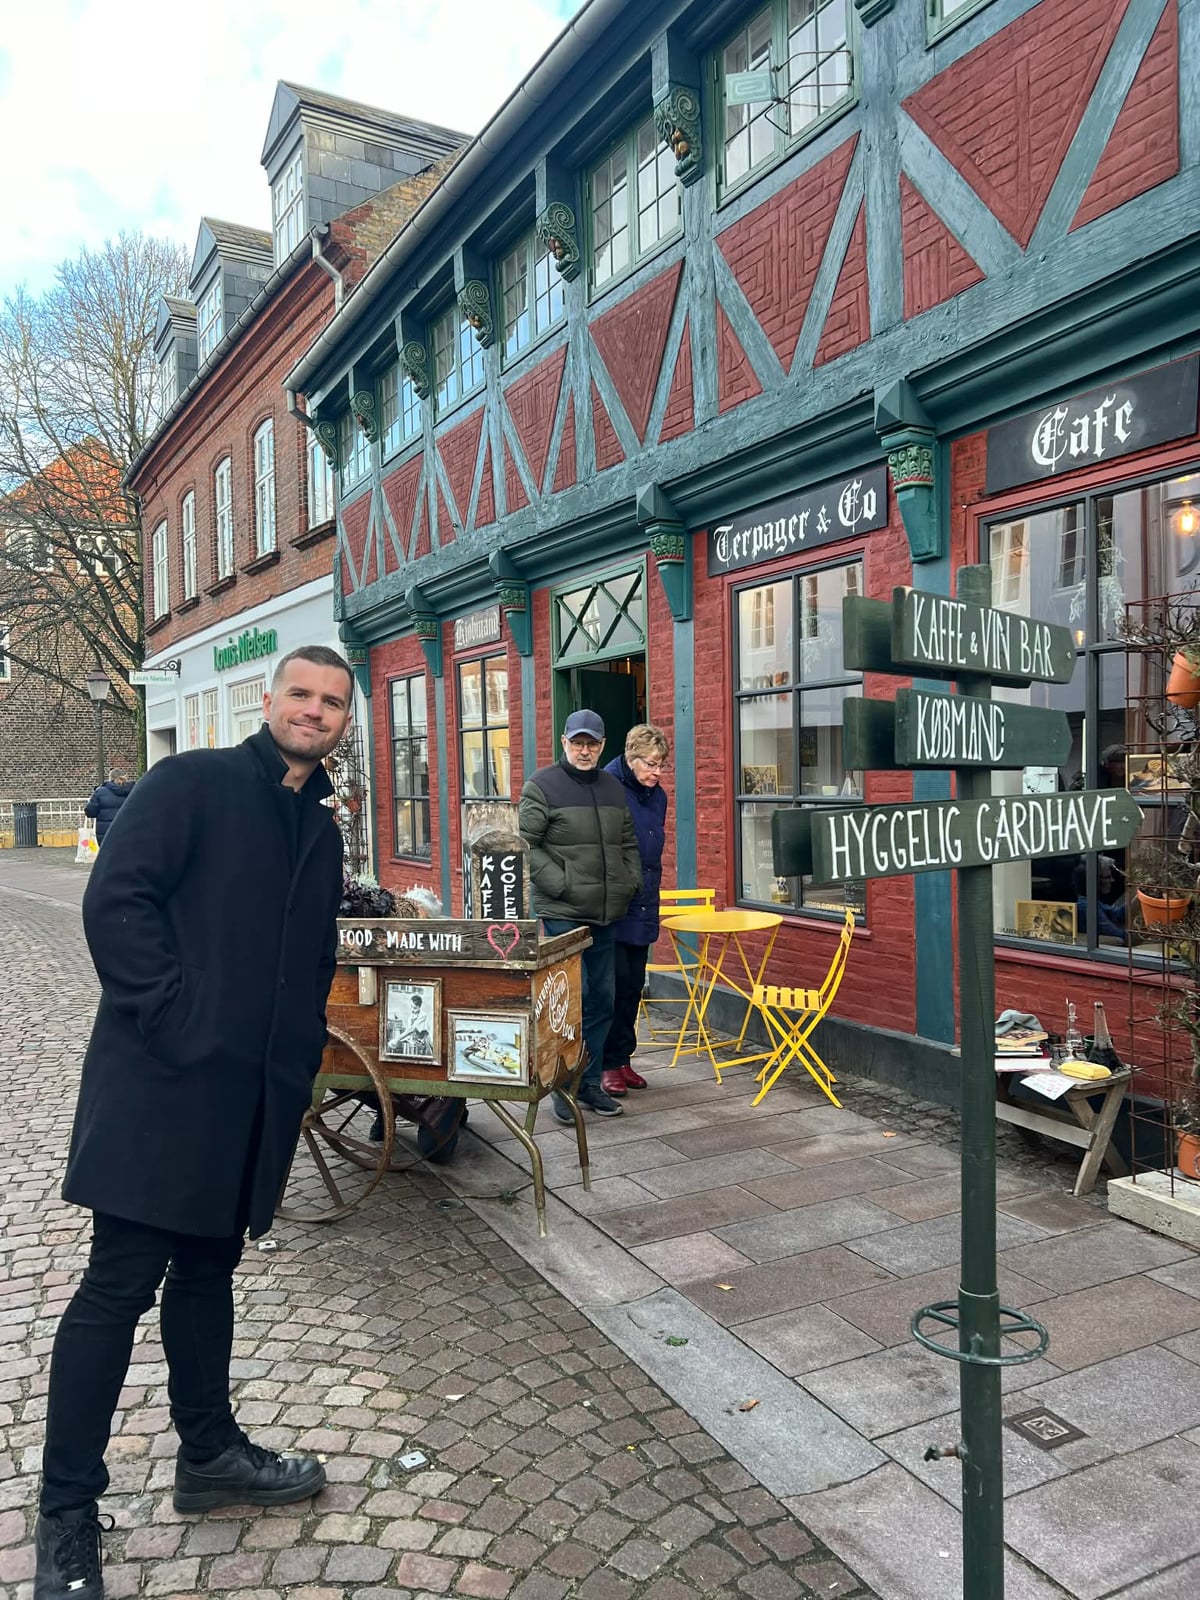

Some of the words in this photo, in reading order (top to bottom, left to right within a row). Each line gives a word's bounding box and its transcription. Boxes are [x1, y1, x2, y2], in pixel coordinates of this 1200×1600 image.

[1031, 393, 1134, 473] Cafe
[713, 508, 811, 568] Terpager
[816, 505, 831, 534] &
[838, 479, 877, 533] Co
[213, 637, 238, 672] Louis
[238, 627, 278, 664] Nielsen
[913, 594, 967, 664] KAFFE
[970, 631, 978, 656] &
[980, 608, 1011, 671] VIN
[1020, 620, 1055, 677] BAR
[917, 695, 1005, 762] KØBMAND
[828, 806, 962, 879] HYGGELIG
[976, 794, 1118, 862] GÅRDHAVE
[480, 855, 495, 919] KAFF
[500, 855, 519, 919] COFFE
[339, 929, 373, 947] FOOD
[386, 930, 425, 950] MADE
[429, 932, 462, 953] WITH
